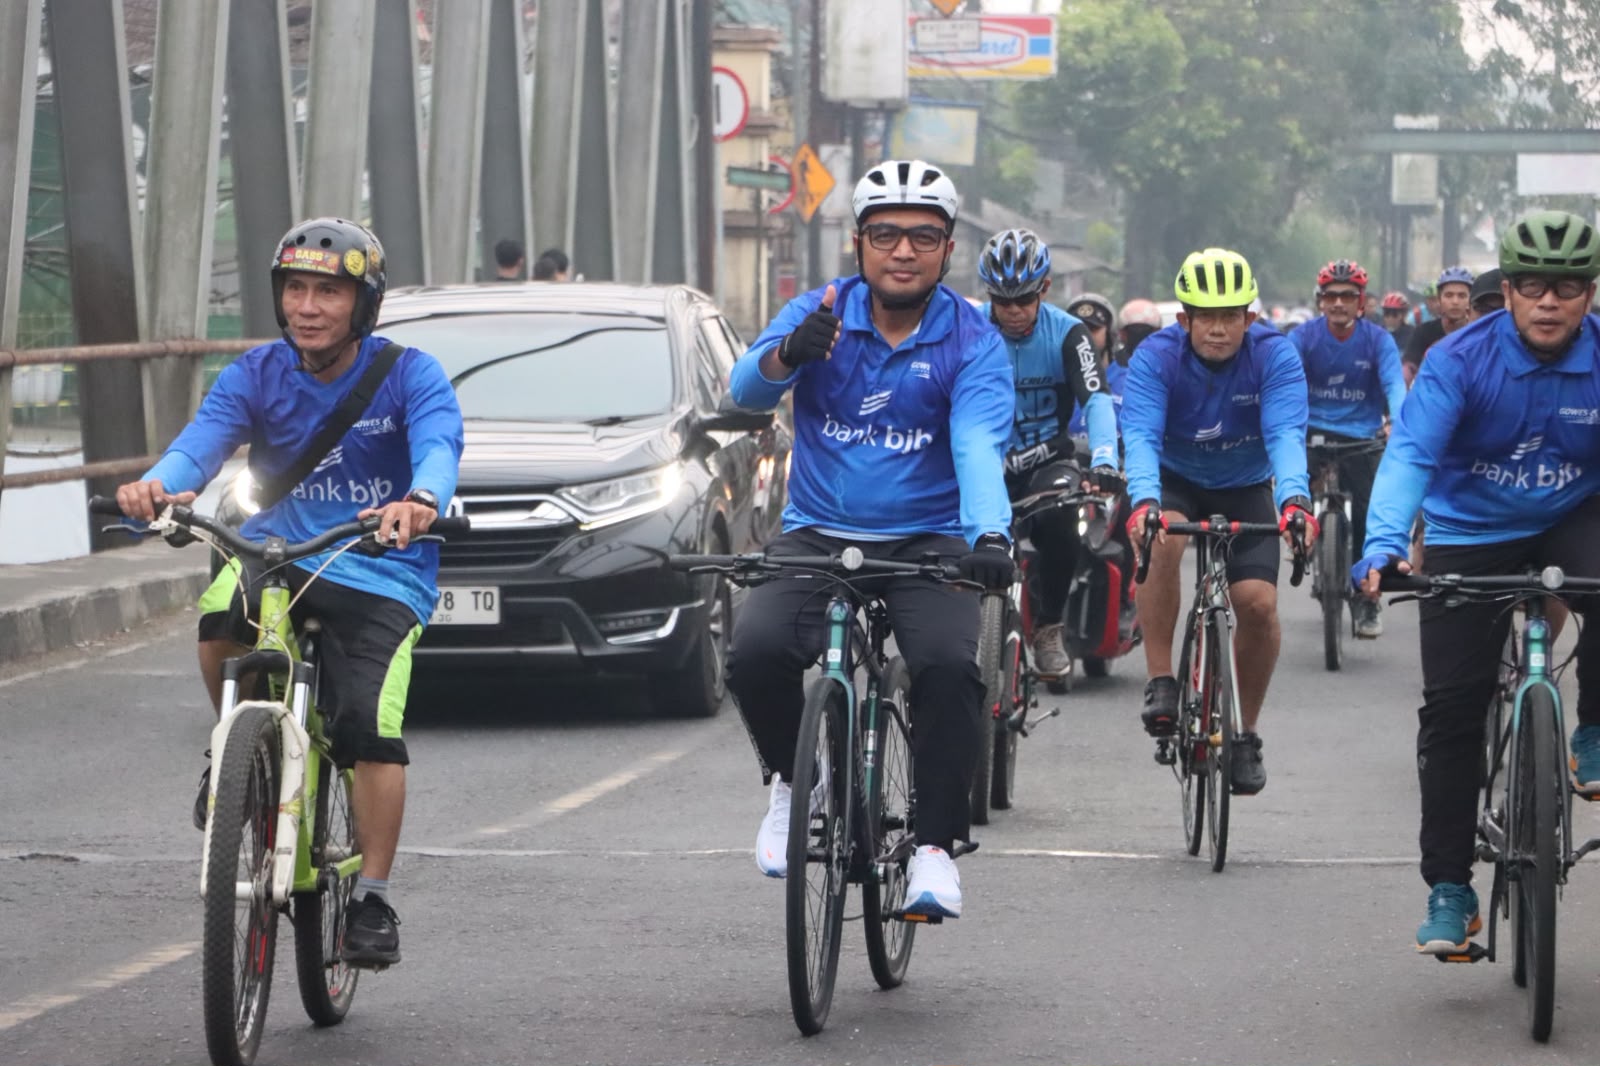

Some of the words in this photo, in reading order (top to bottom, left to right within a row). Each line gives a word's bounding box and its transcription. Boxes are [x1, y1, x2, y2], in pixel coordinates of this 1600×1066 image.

[1342, 388, 1366, 401] bjb
[352, 418, 381, 428] OWES
[822, 414, 877, 447] bank
[1471, 459, 1528, 489] bank
[290, 477, 342, 502] ank
[348, 477, 392, 508] bjb
[471, 591, 494, 611] TQ
